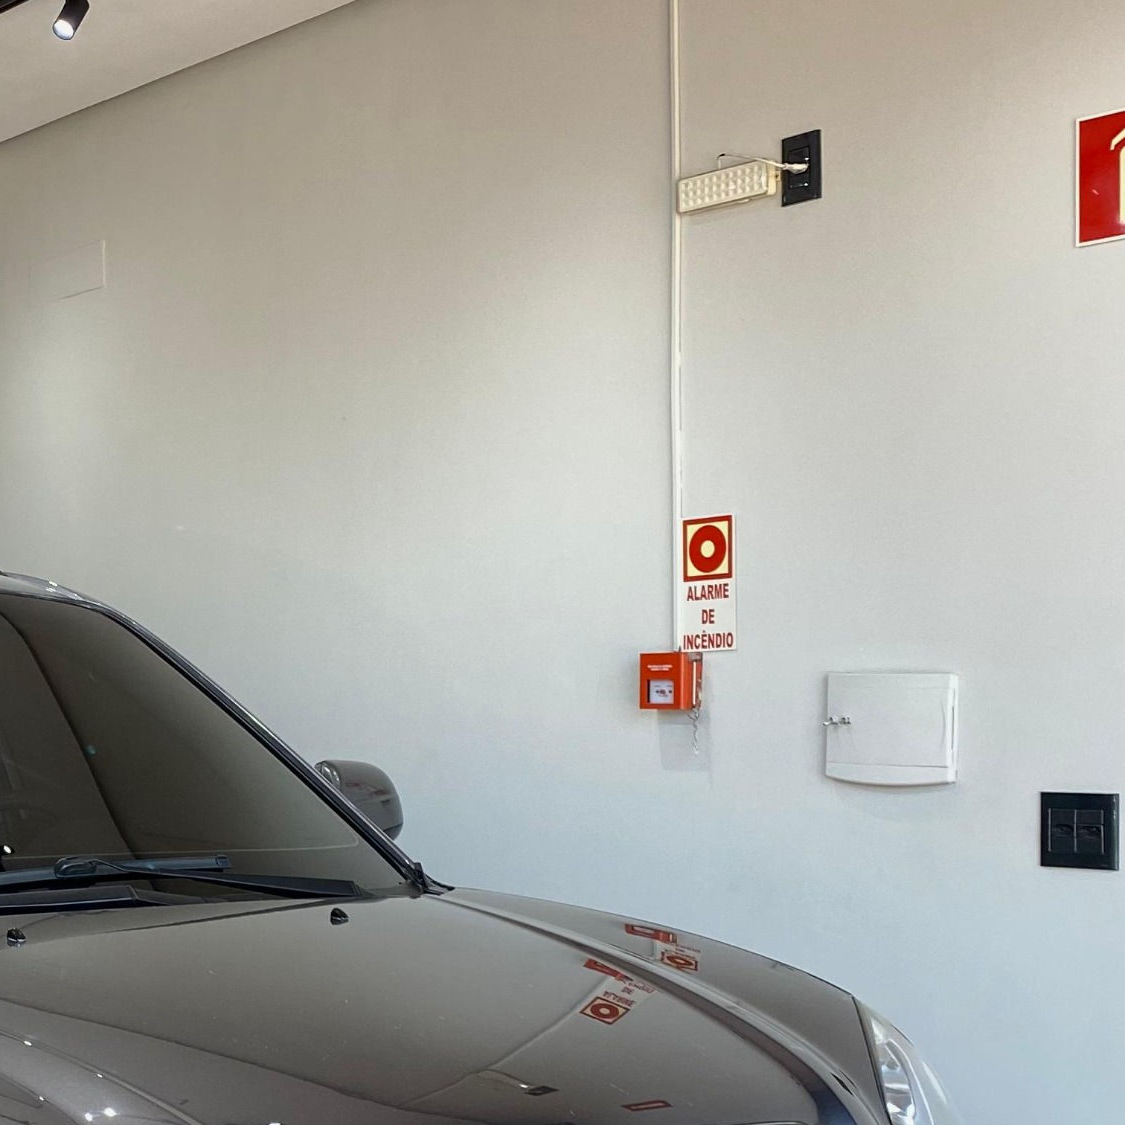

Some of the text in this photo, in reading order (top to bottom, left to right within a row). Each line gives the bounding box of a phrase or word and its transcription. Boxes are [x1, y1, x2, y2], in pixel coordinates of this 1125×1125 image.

[686, 583, 729, 601] ALARME
[701, 609, 715, 624] DE
[683, 630, 734, 649] INCÊNDIO
